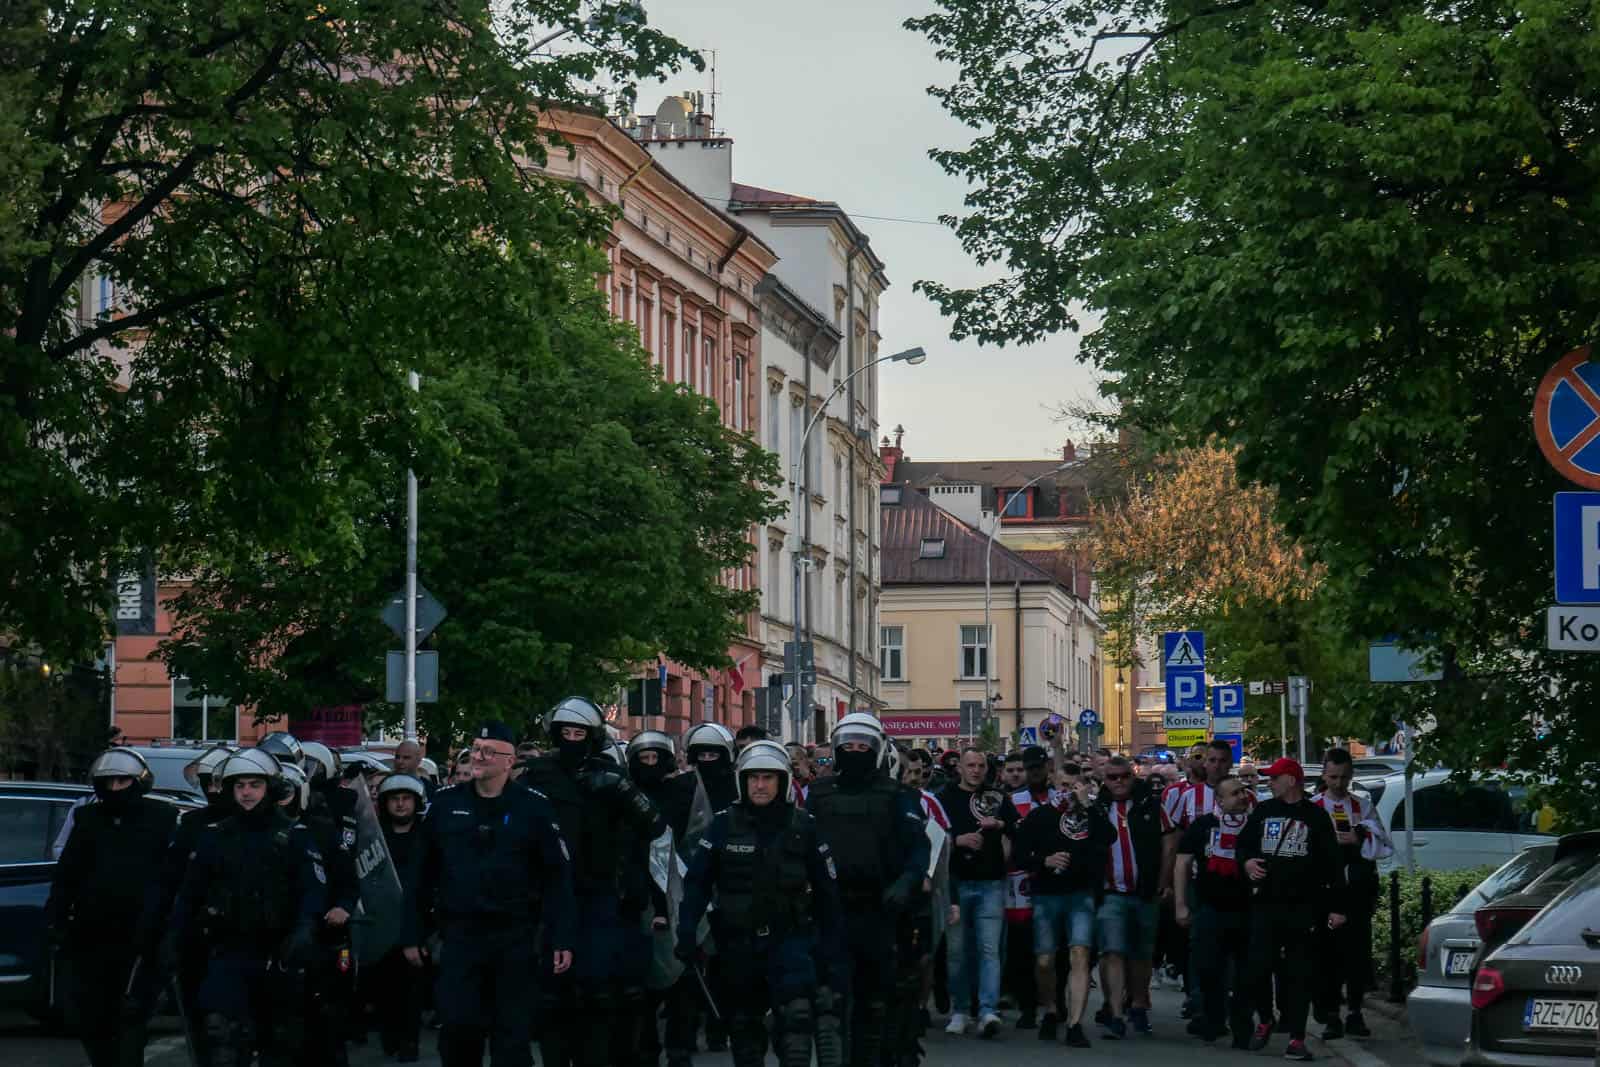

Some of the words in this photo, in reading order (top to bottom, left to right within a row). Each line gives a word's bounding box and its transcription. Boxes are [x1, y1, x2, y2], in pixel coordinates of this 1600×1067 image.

[1559, 615, 1598, 641] Ko
[1174, 677, 1197, 707] P
[1219, 689, 1237, 713] P
[1166, 716, 1206, 726] Koniec
[1533, 1002, 1563, 1025] RZE
